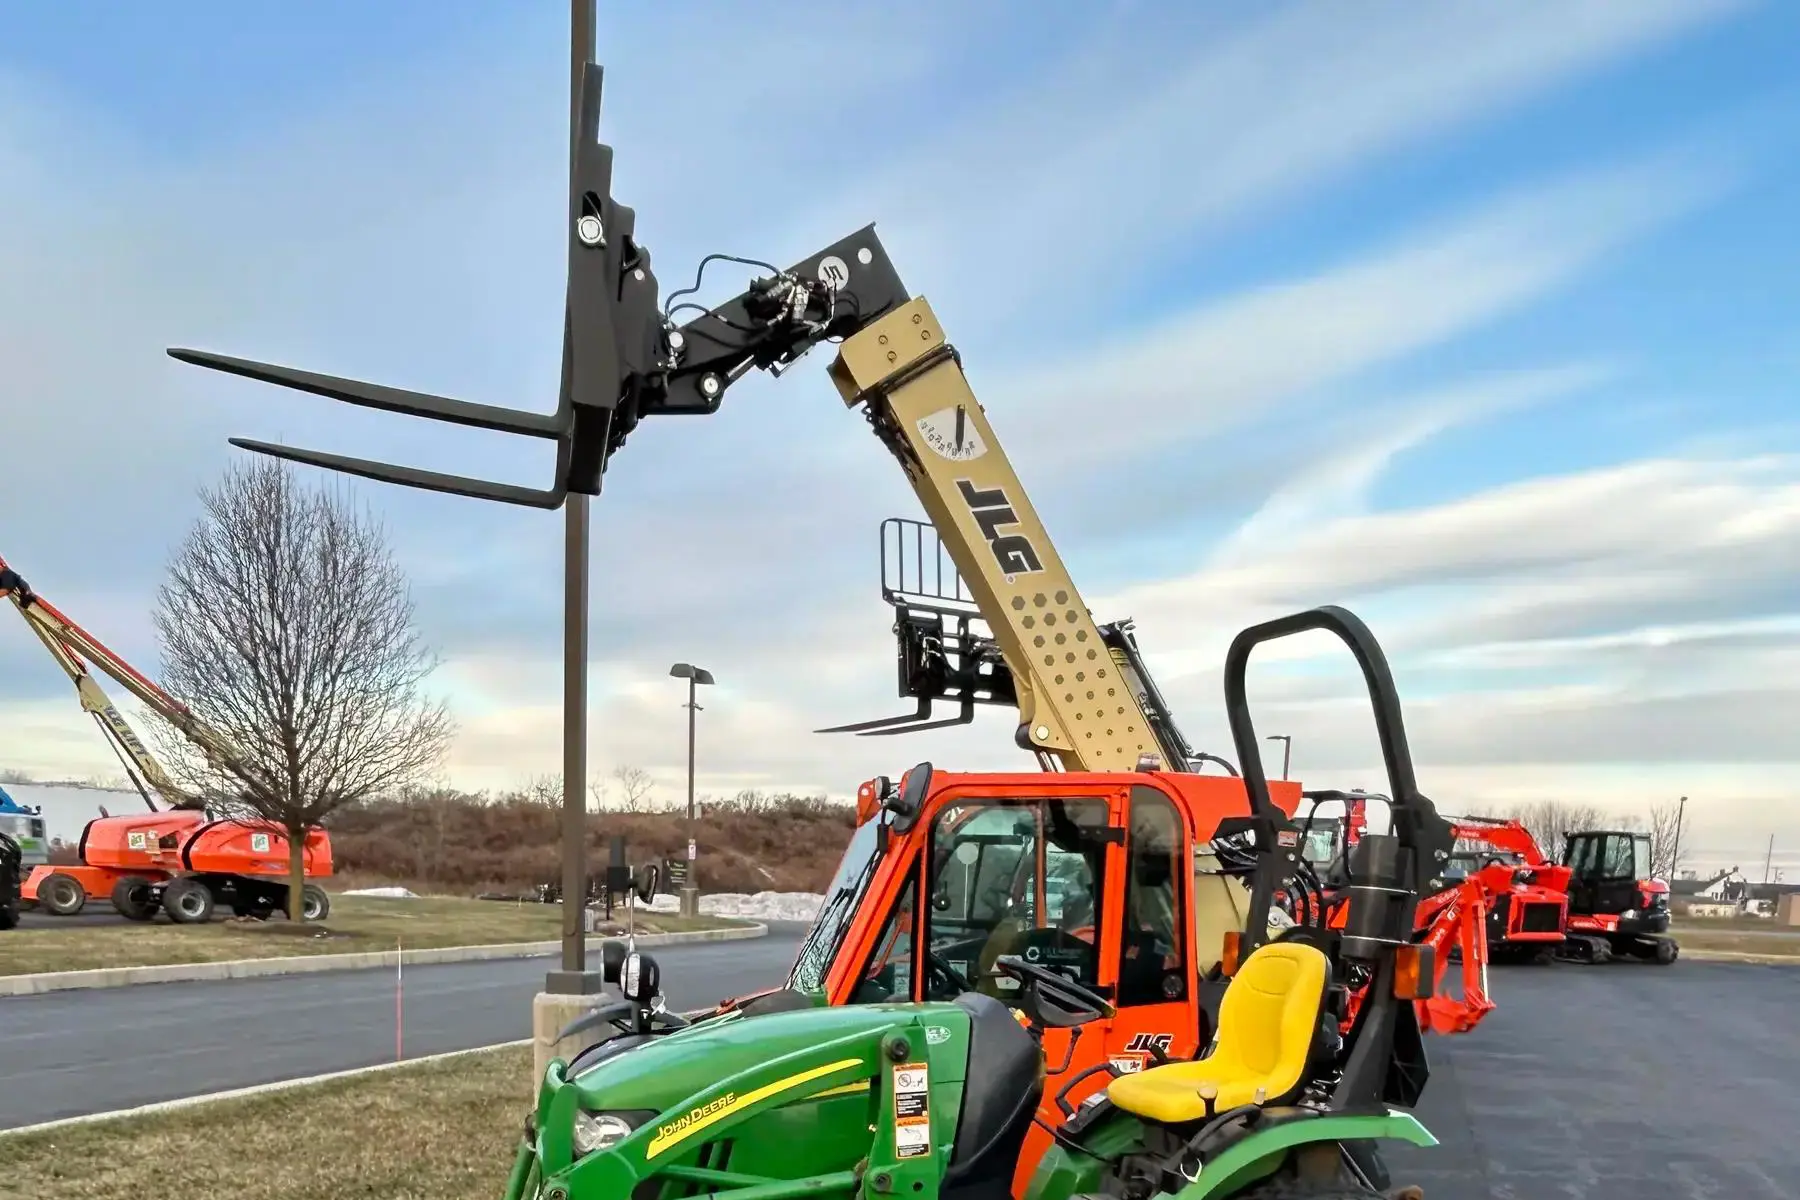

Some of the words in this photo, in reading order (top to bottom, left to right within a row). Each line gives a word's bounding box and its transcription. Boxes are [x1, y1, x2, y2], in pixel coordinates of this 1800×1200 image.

[954, 478, 1046, 577] JLG
[1124, 1033, 1174, 1053] JLG
[656, 1114, 692, 1141] JOHN
[690, 1091, 736, 1123] DEERE
